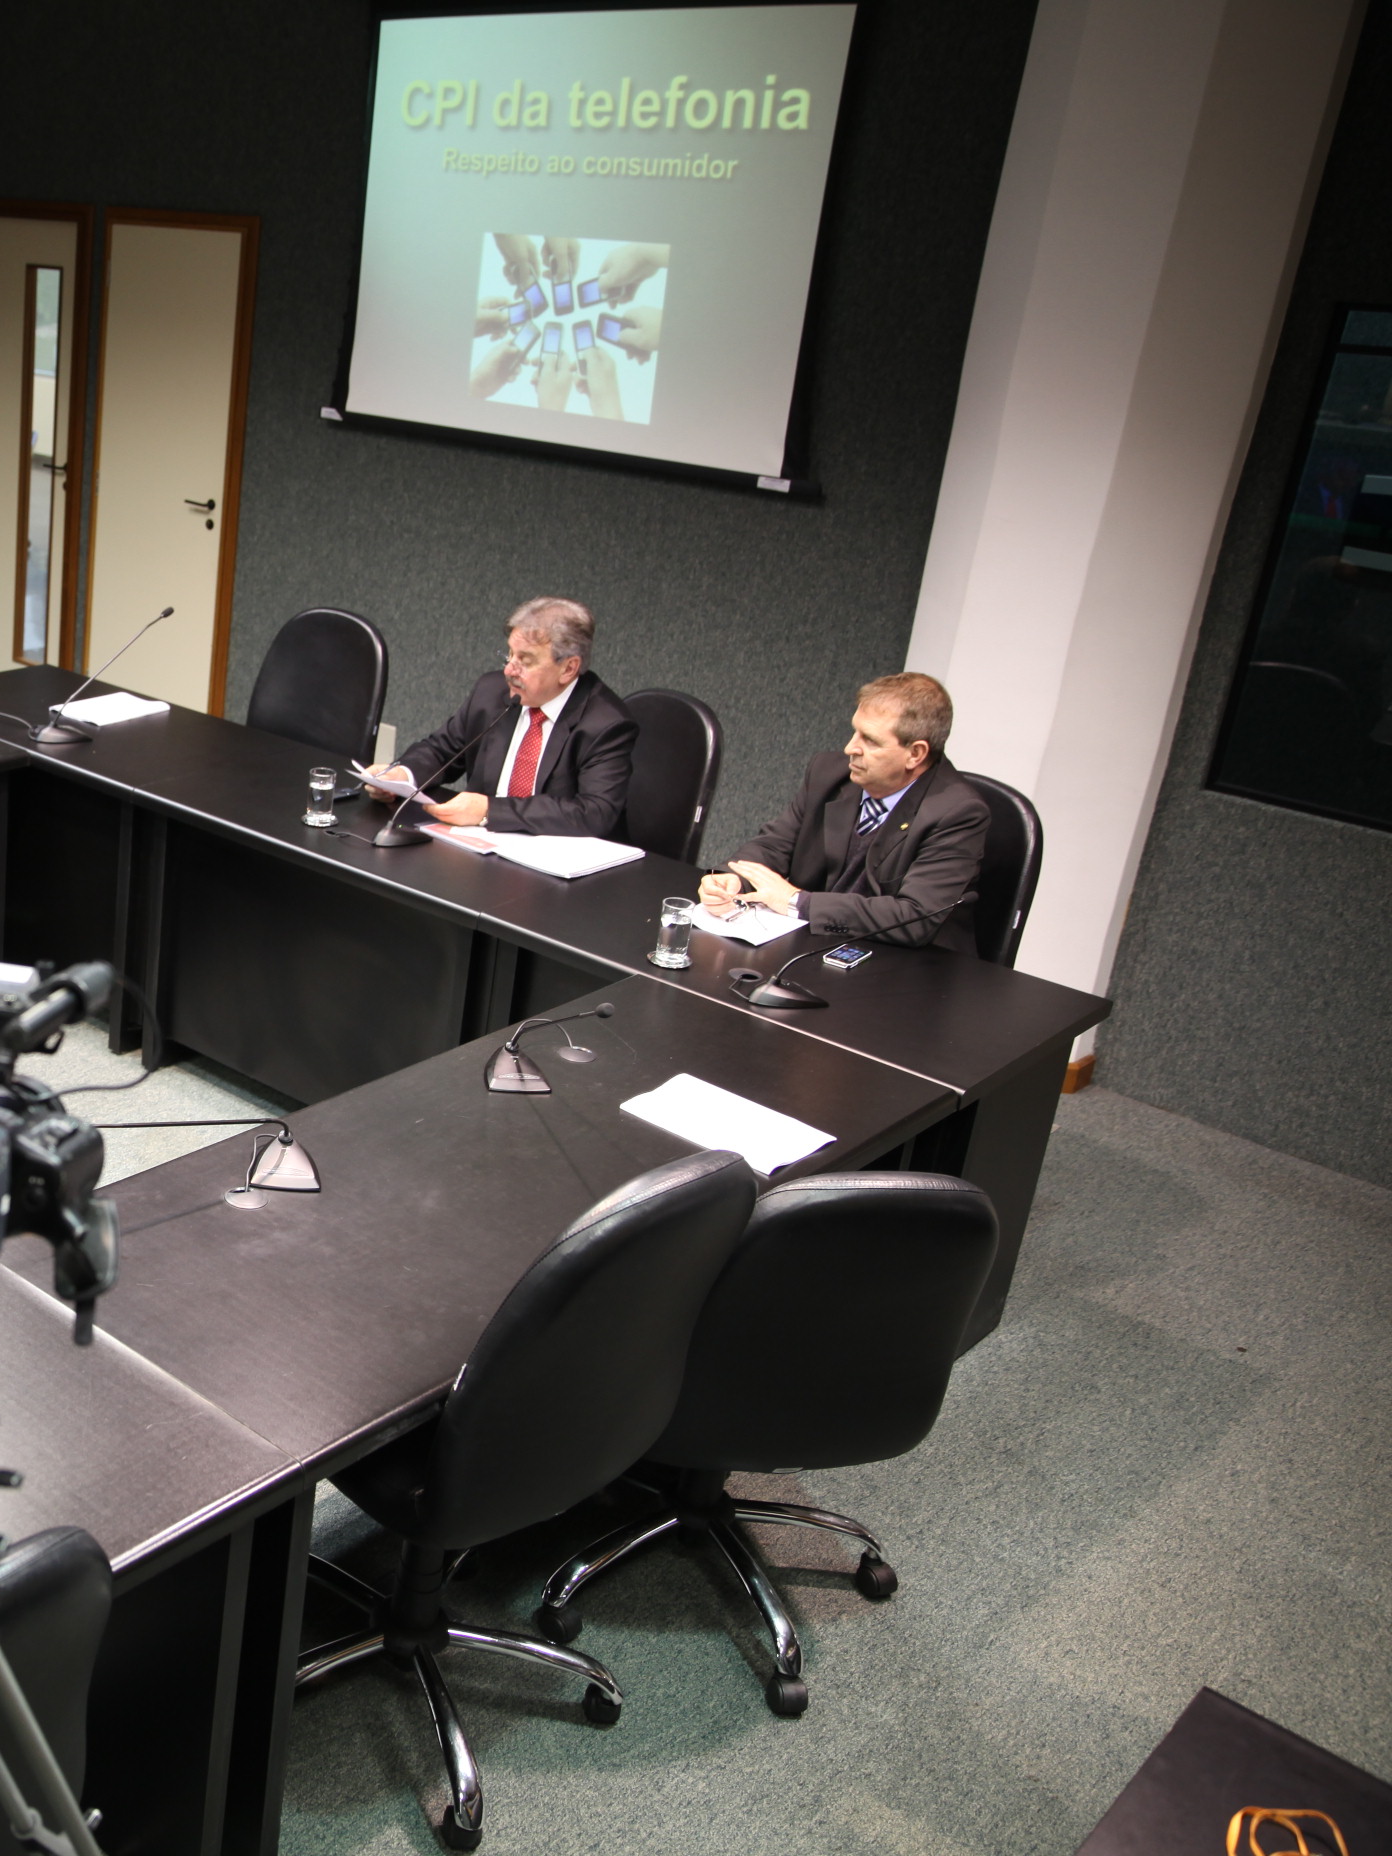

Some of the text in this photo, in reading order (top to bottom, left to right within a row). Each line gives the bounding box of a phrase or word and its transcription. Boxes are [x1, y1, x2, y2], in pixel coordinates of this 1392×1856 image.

[401, 74, 811, 130] CPI da telefonia
[442, 148, 739, 179] Respeito ao consumidor
